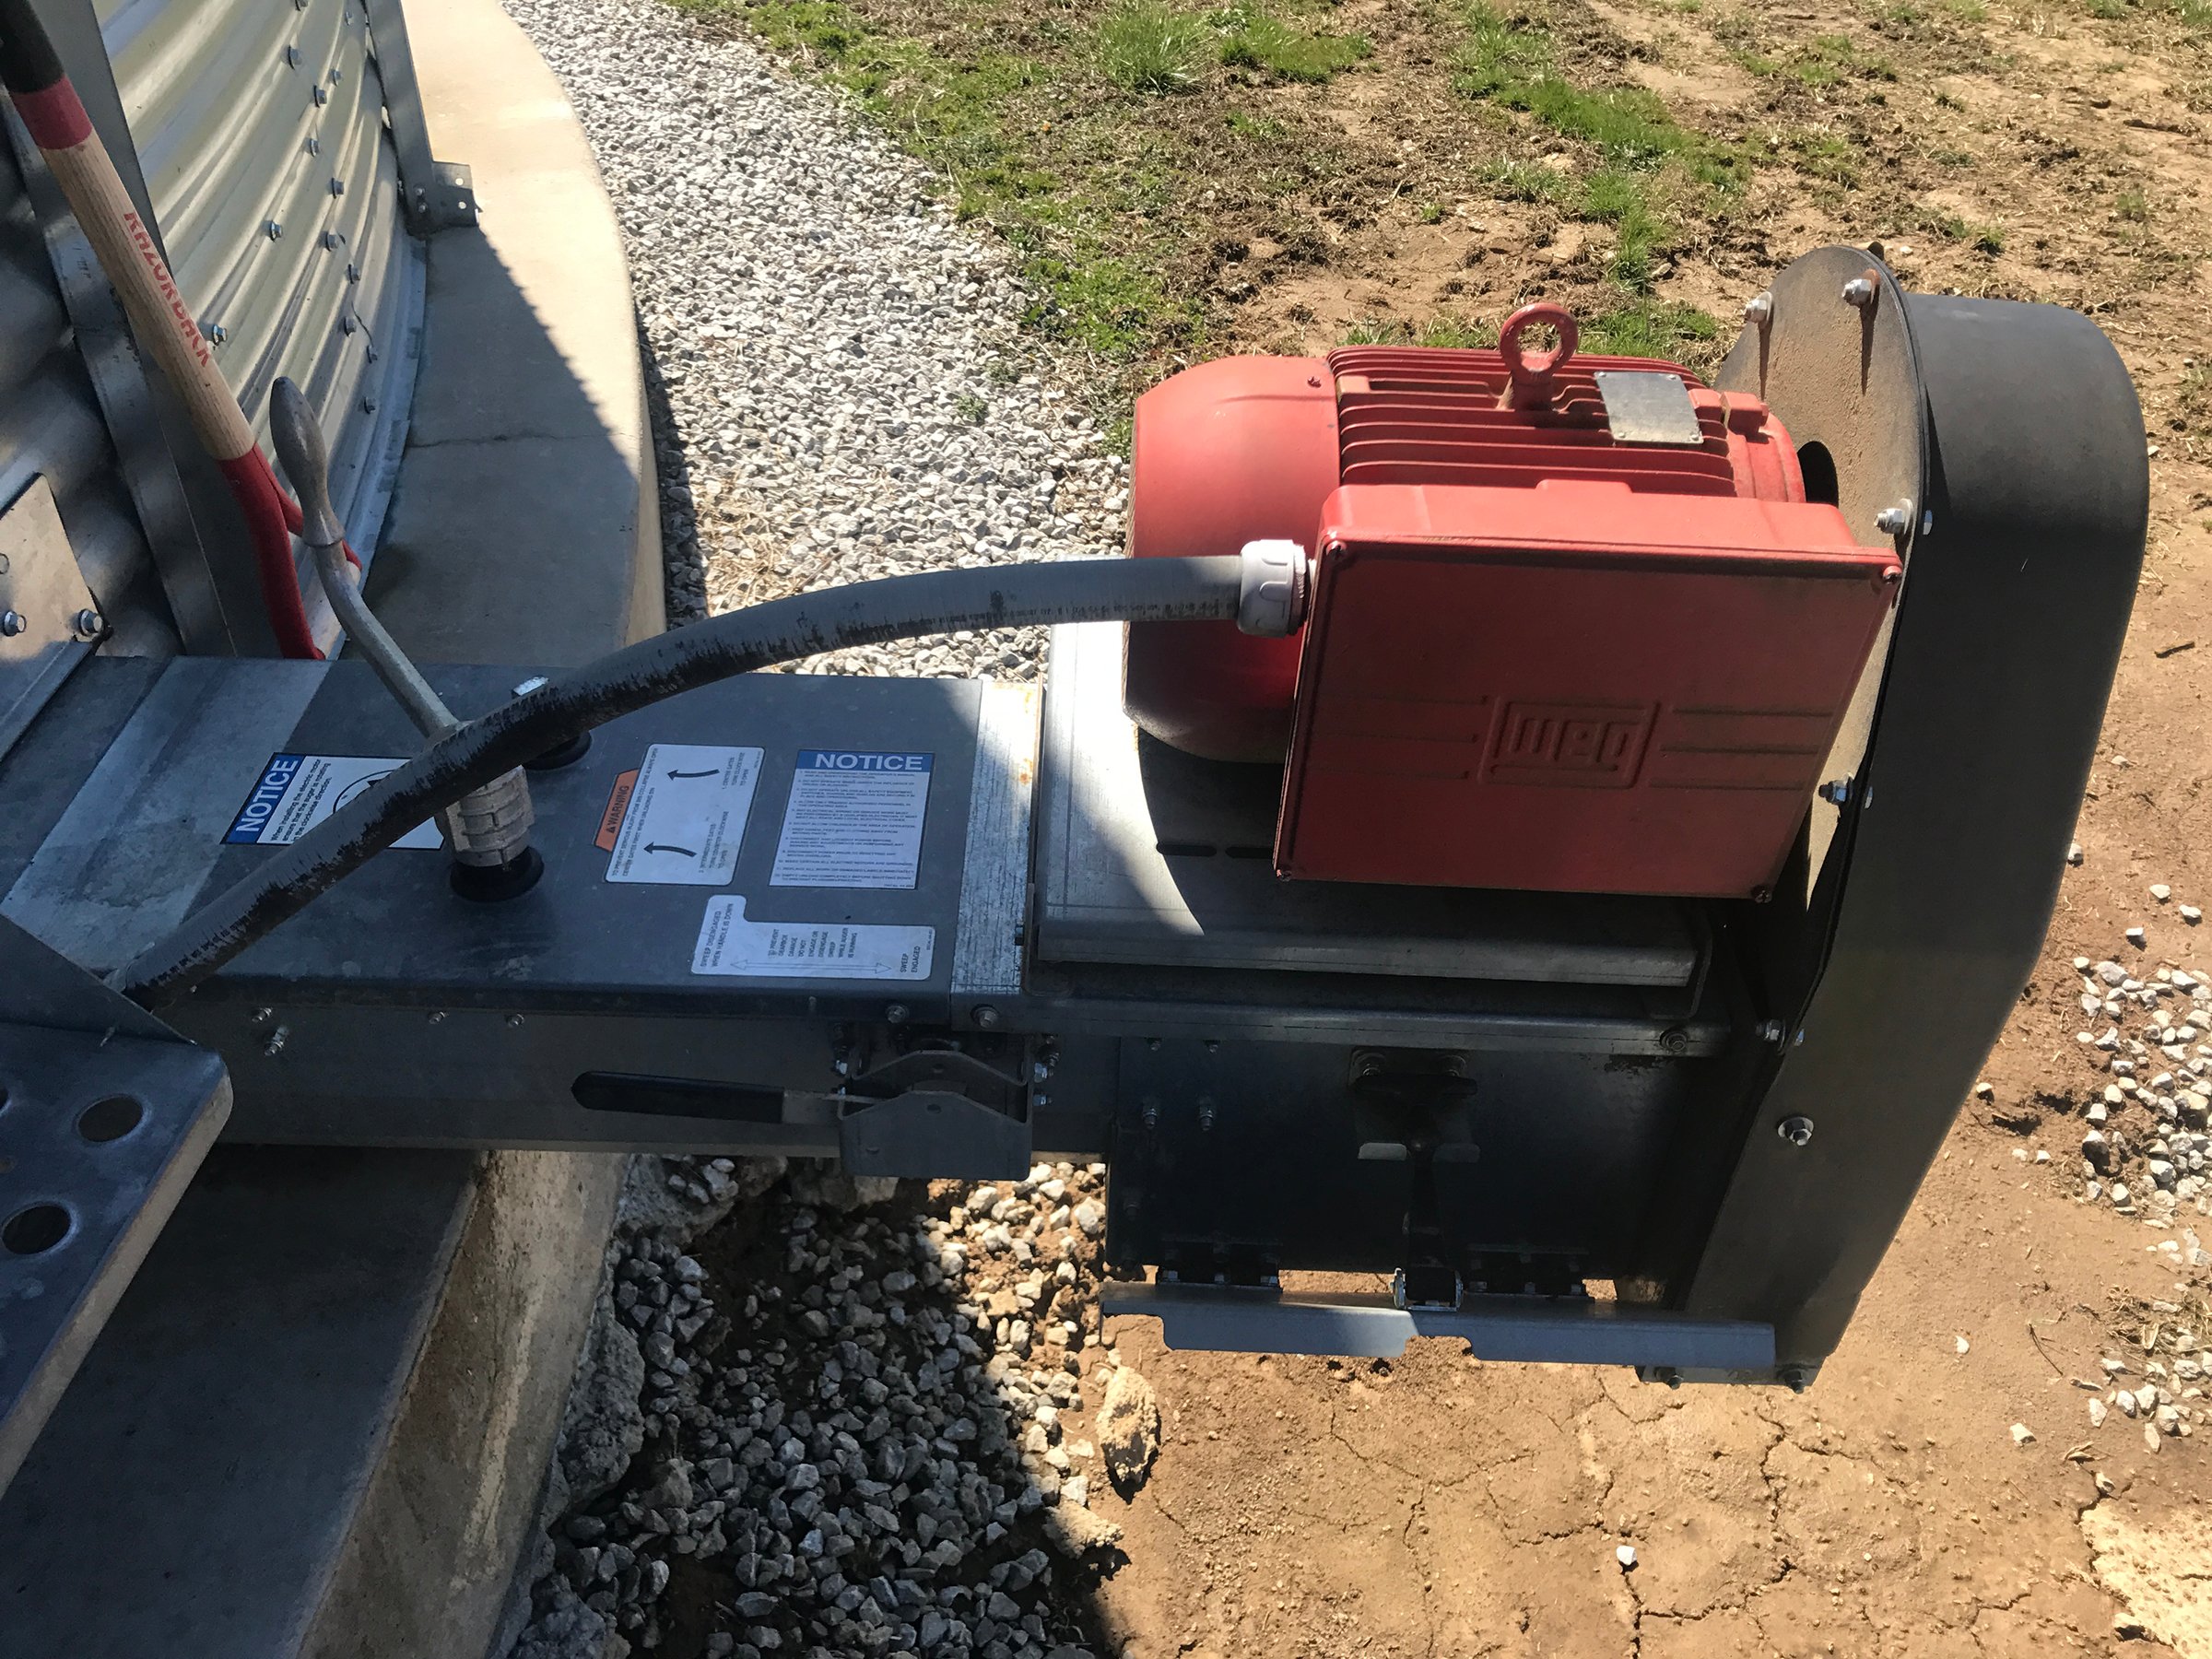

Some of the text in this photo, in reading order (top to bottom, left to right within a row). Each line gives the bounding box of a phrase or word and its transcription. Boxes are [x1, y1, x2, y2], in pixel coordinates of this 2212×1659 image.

[815, 753, 924, 771] NOTICE
[235, 759, 299, 831] NOTICE
[270, 759, 321, 841] When installing the electric motor
[607, 785, 629, 825] WARNING
[282, 823, 297, 841] ensure
[291, 812, 302, 822] that
[298, 803, 308, 811] the
[295, 827, 304, 835] the
[301, 801, 319, 826] clockwise
[700, 947, 711, 966] SWEEP
[900, 953, 909, 973] SWEEP
[911, 946, 921, 973] ENGAGED
